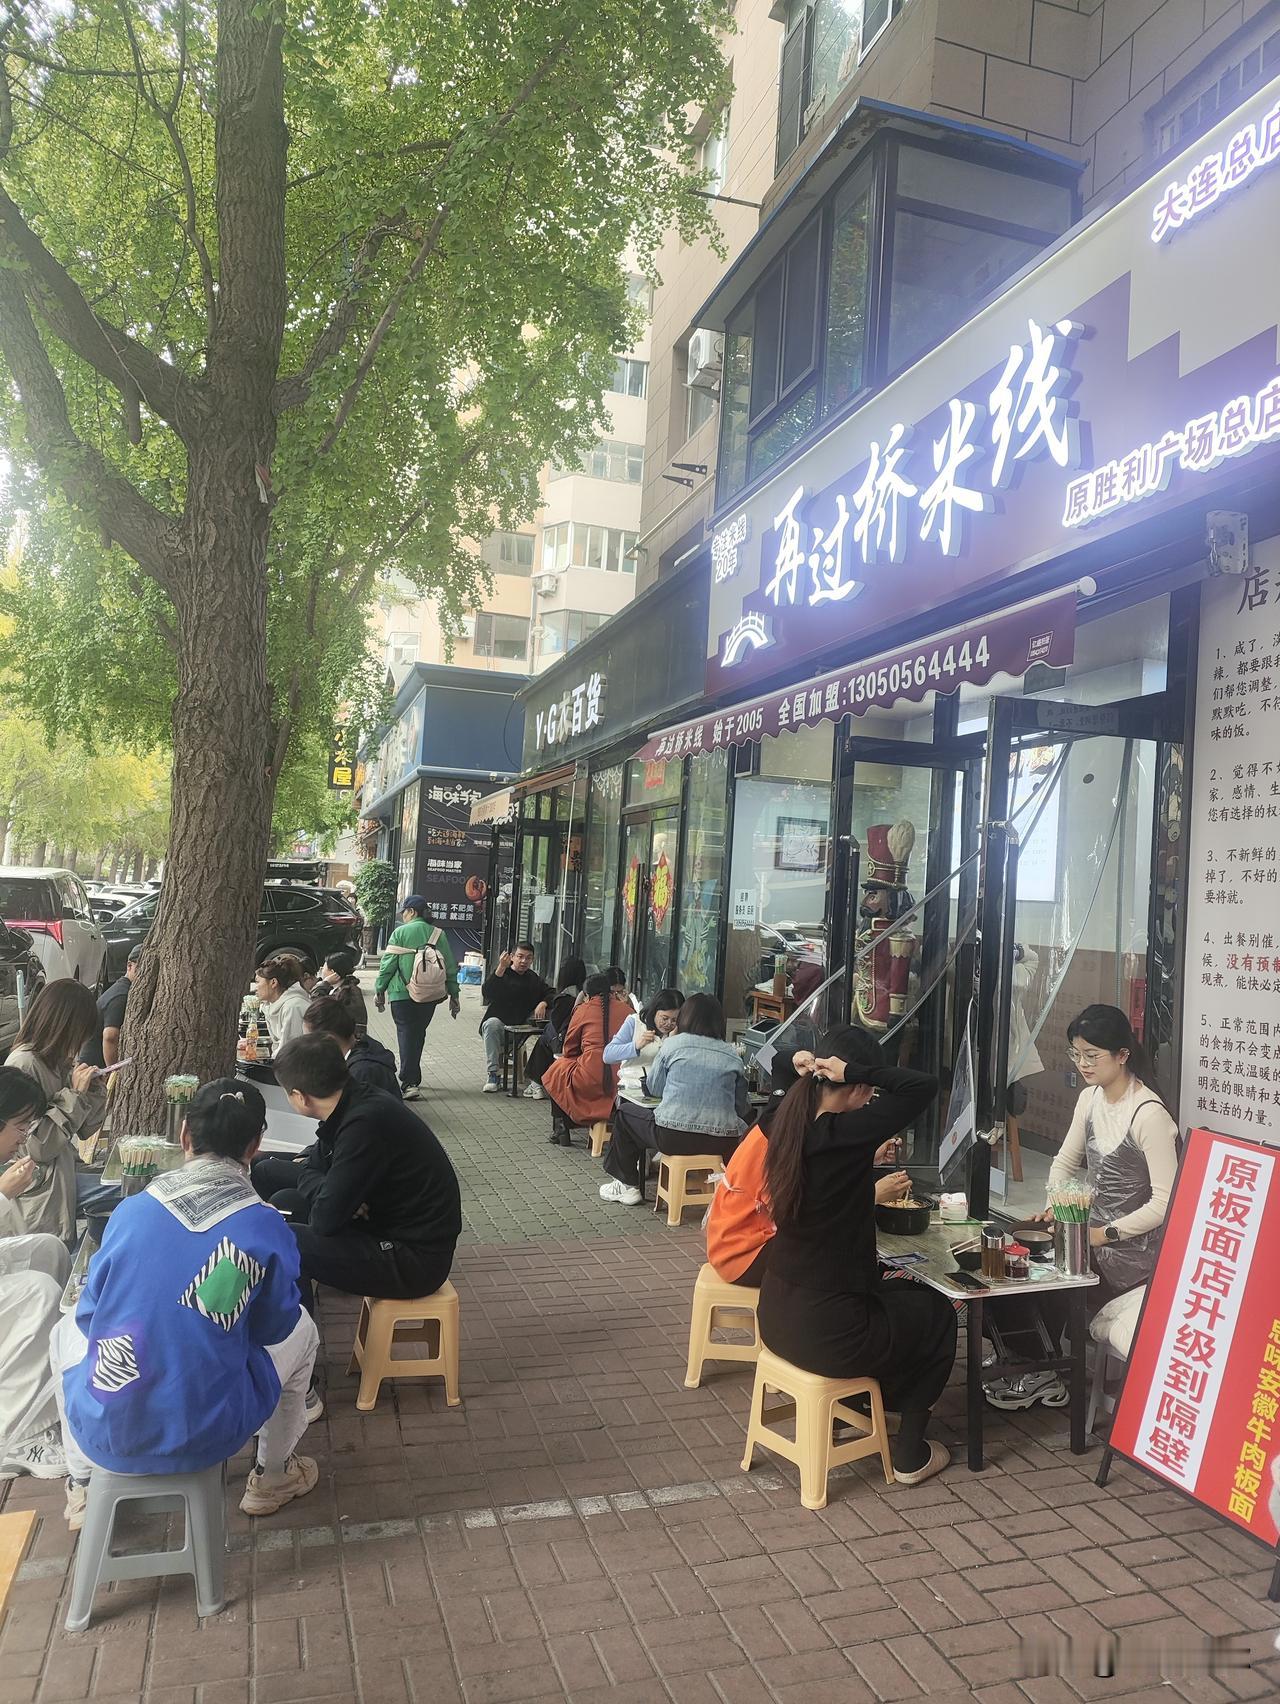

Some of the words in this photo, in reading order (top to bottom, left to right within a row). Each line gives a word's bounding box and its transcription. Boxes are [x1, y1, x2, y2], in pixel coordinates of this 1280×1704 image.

[1152, 100, 1280, 243] 大连总店
[765, 318, 1076, 607] 再过桥米线
[1063, 375, 1280, 527] 原胜利广场总店
[655, 724, 704, 756] 再过桥米线
[712, 708, 764, 744] 始于2005
[1210, 723, 1250, 741] 味的饭。
[1207, 803, 1280, 822] 您有选择的权
[1204, 889, 1244, 905] 要将就。
[1197, 1096, 1273, 1127] 敢生活的力量。
[1145, 1153, 1263, 1479] 原板面店升级到隔壁
